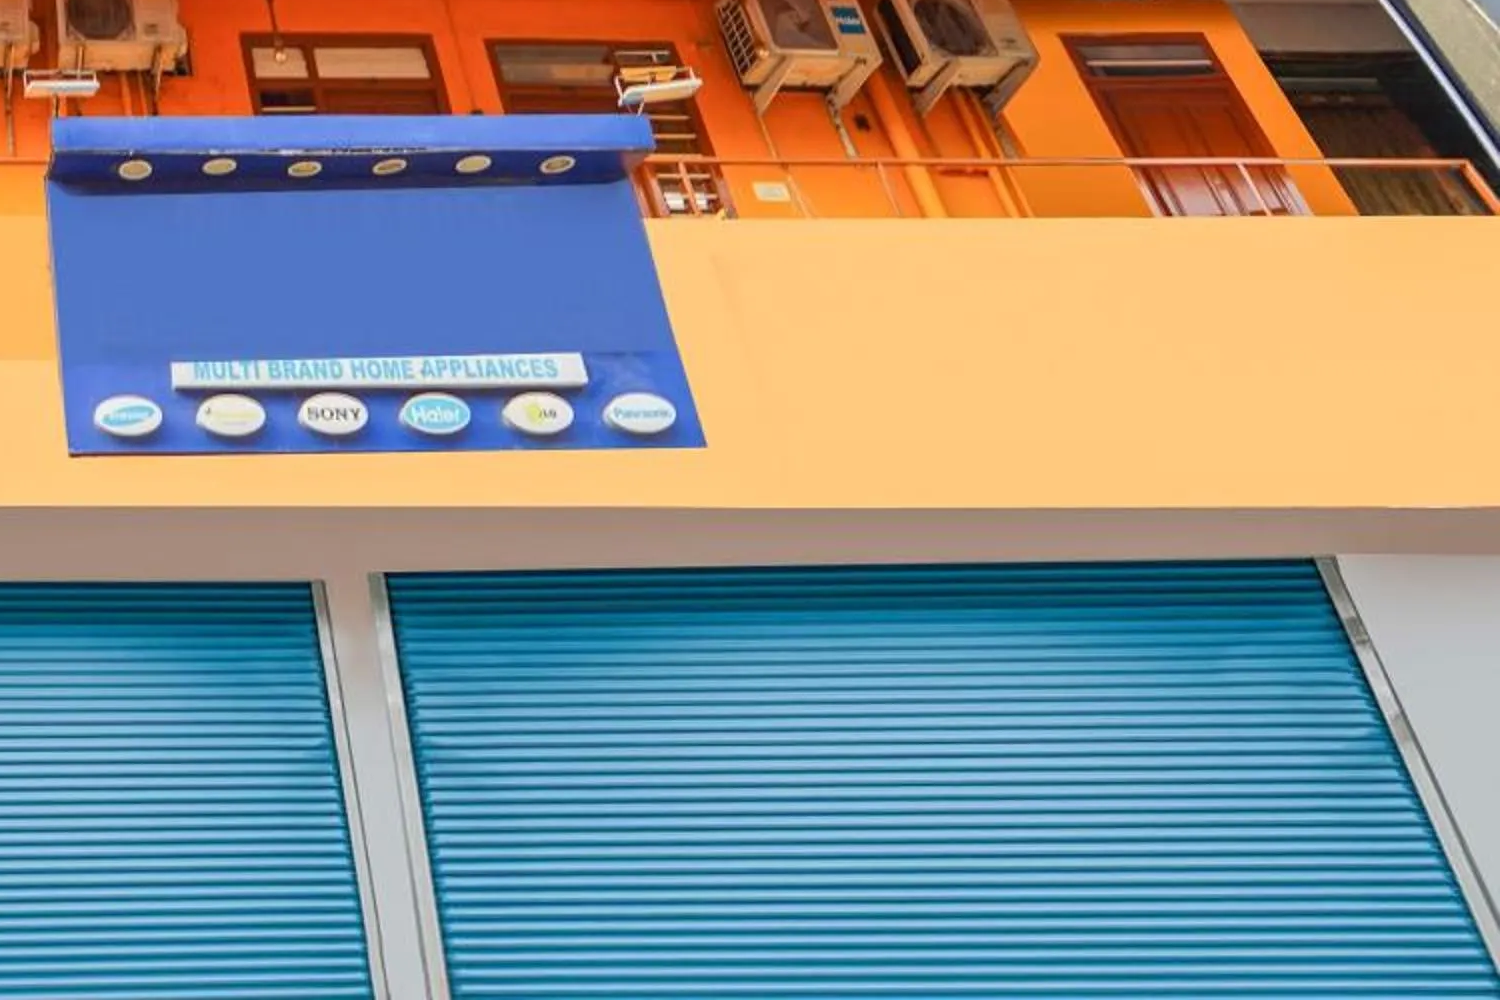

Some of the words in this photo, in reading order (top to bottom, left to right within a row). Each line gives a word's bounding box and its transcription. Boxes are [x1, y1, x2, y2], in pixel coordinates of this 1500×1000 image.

[193, 361, 261, 381] MULTI
[268, 360, 343, 380] BRAND
[351, 359, 415, 380] HOME
[421, 358, 560, 379] APPLIANCES
[307, 407, 361, 422] SONY
[411, 404, 461, 425] Haier
